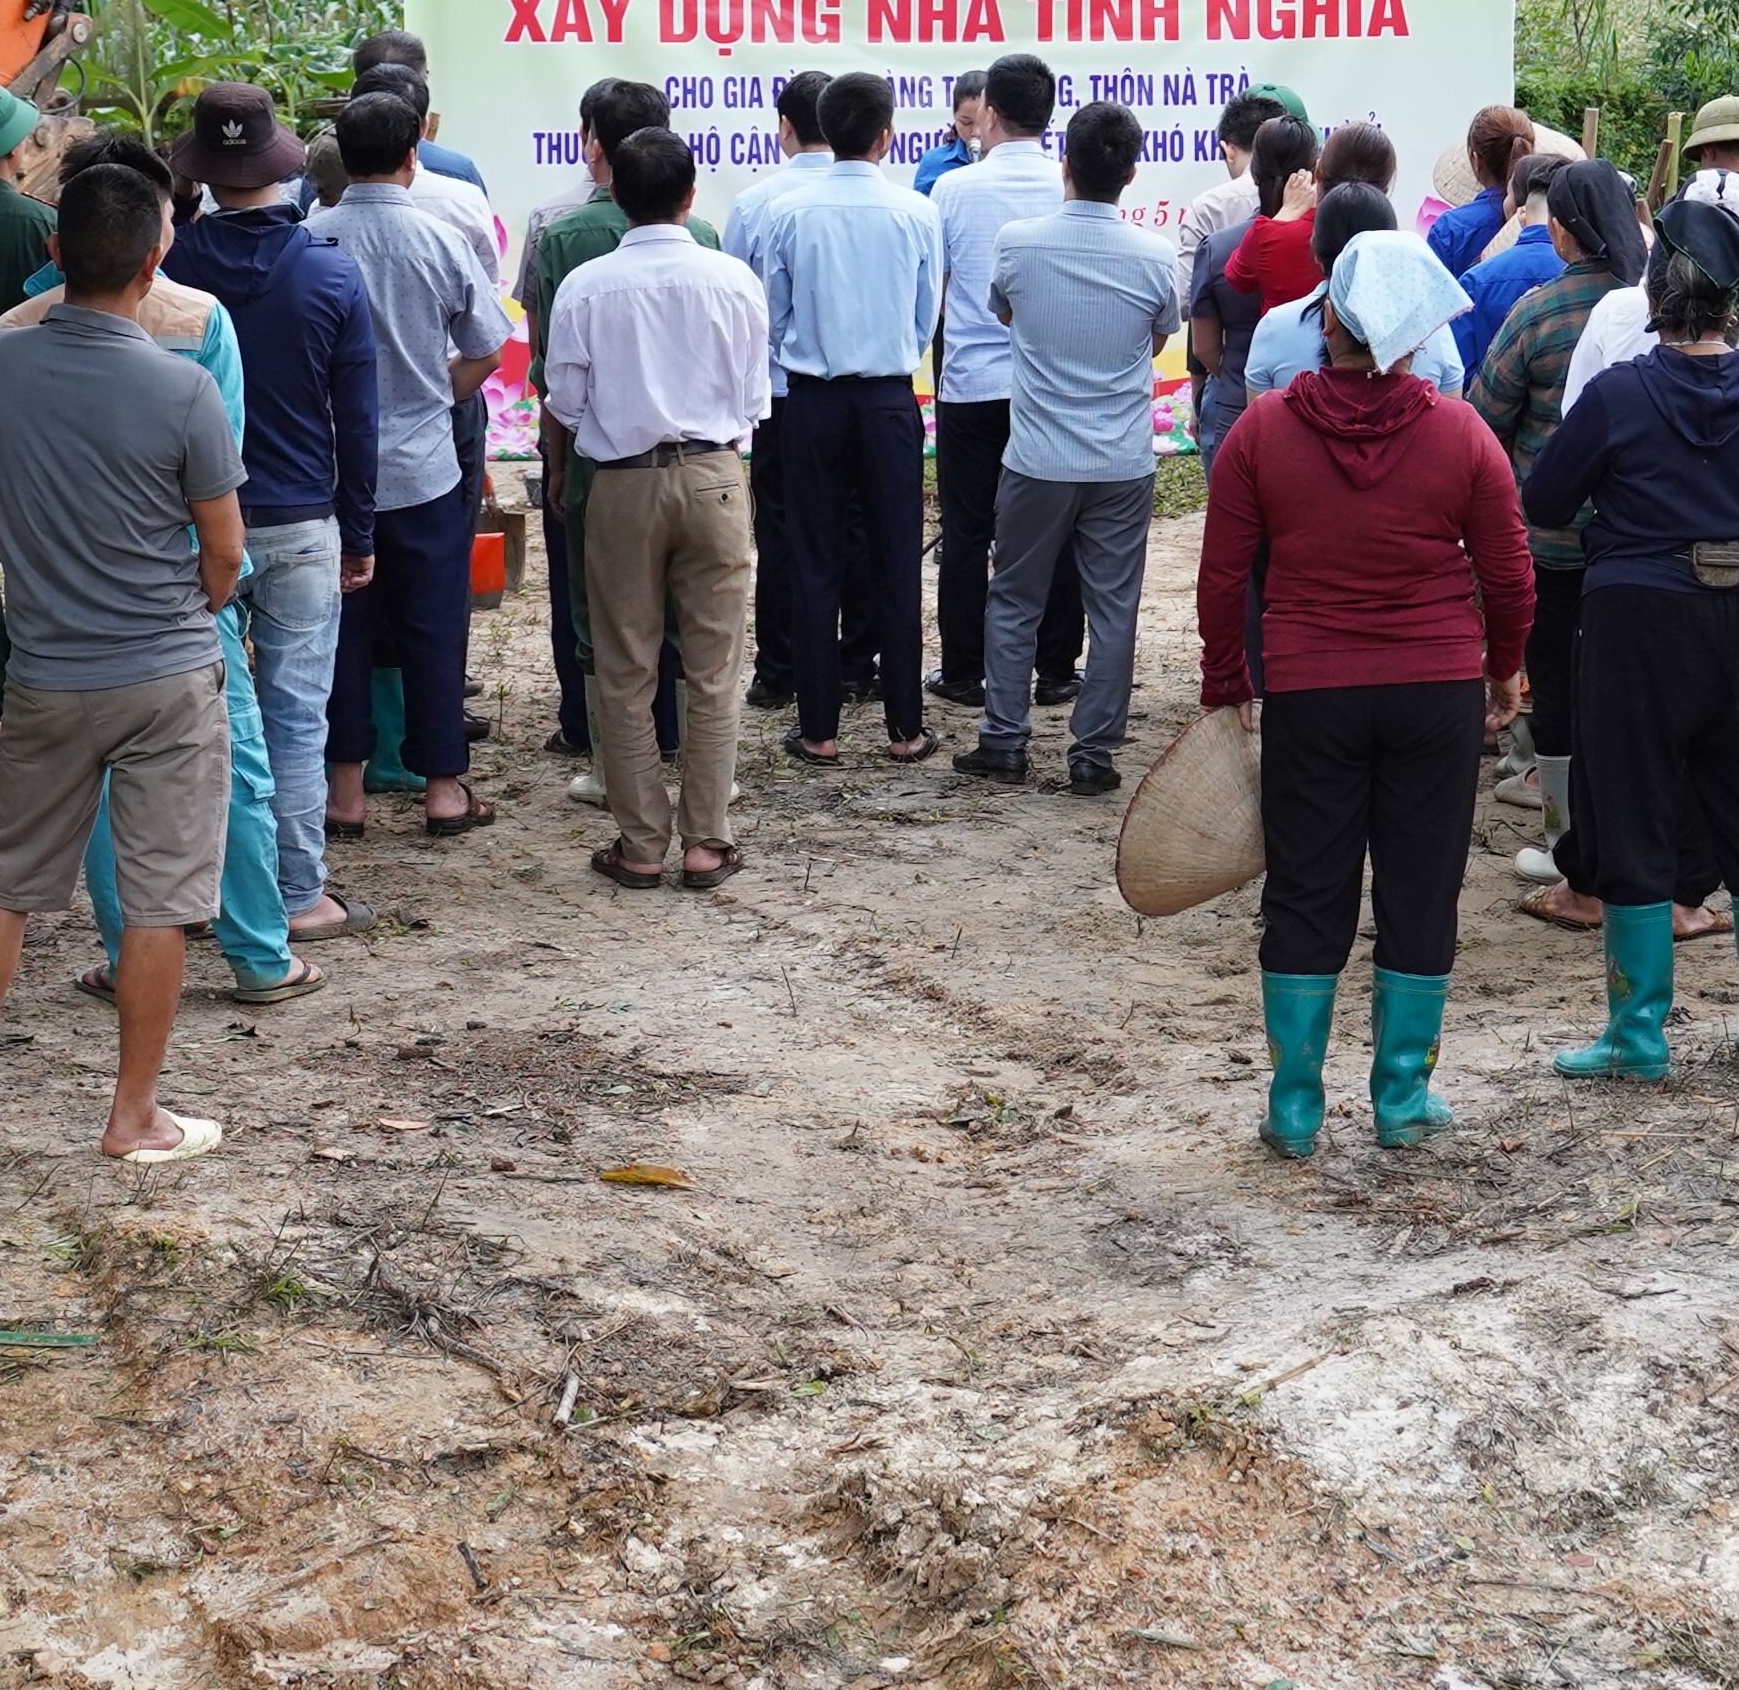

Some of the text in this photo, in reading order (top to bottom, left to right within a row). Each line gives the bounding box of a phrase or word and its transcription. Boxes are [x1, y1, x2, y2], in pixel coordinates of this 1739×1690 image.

[665, 76, 714, 109] CHO
[723, 76, 764, 109] GIA
[1089, 67, 1154, 107] THÔN
[1163, 66, 1197, 106] NÀ
[688, 125, 721, 173] HỘ
[730, 125, 781, 173] CẬN
[1154, 200, 1170, 227] 5
